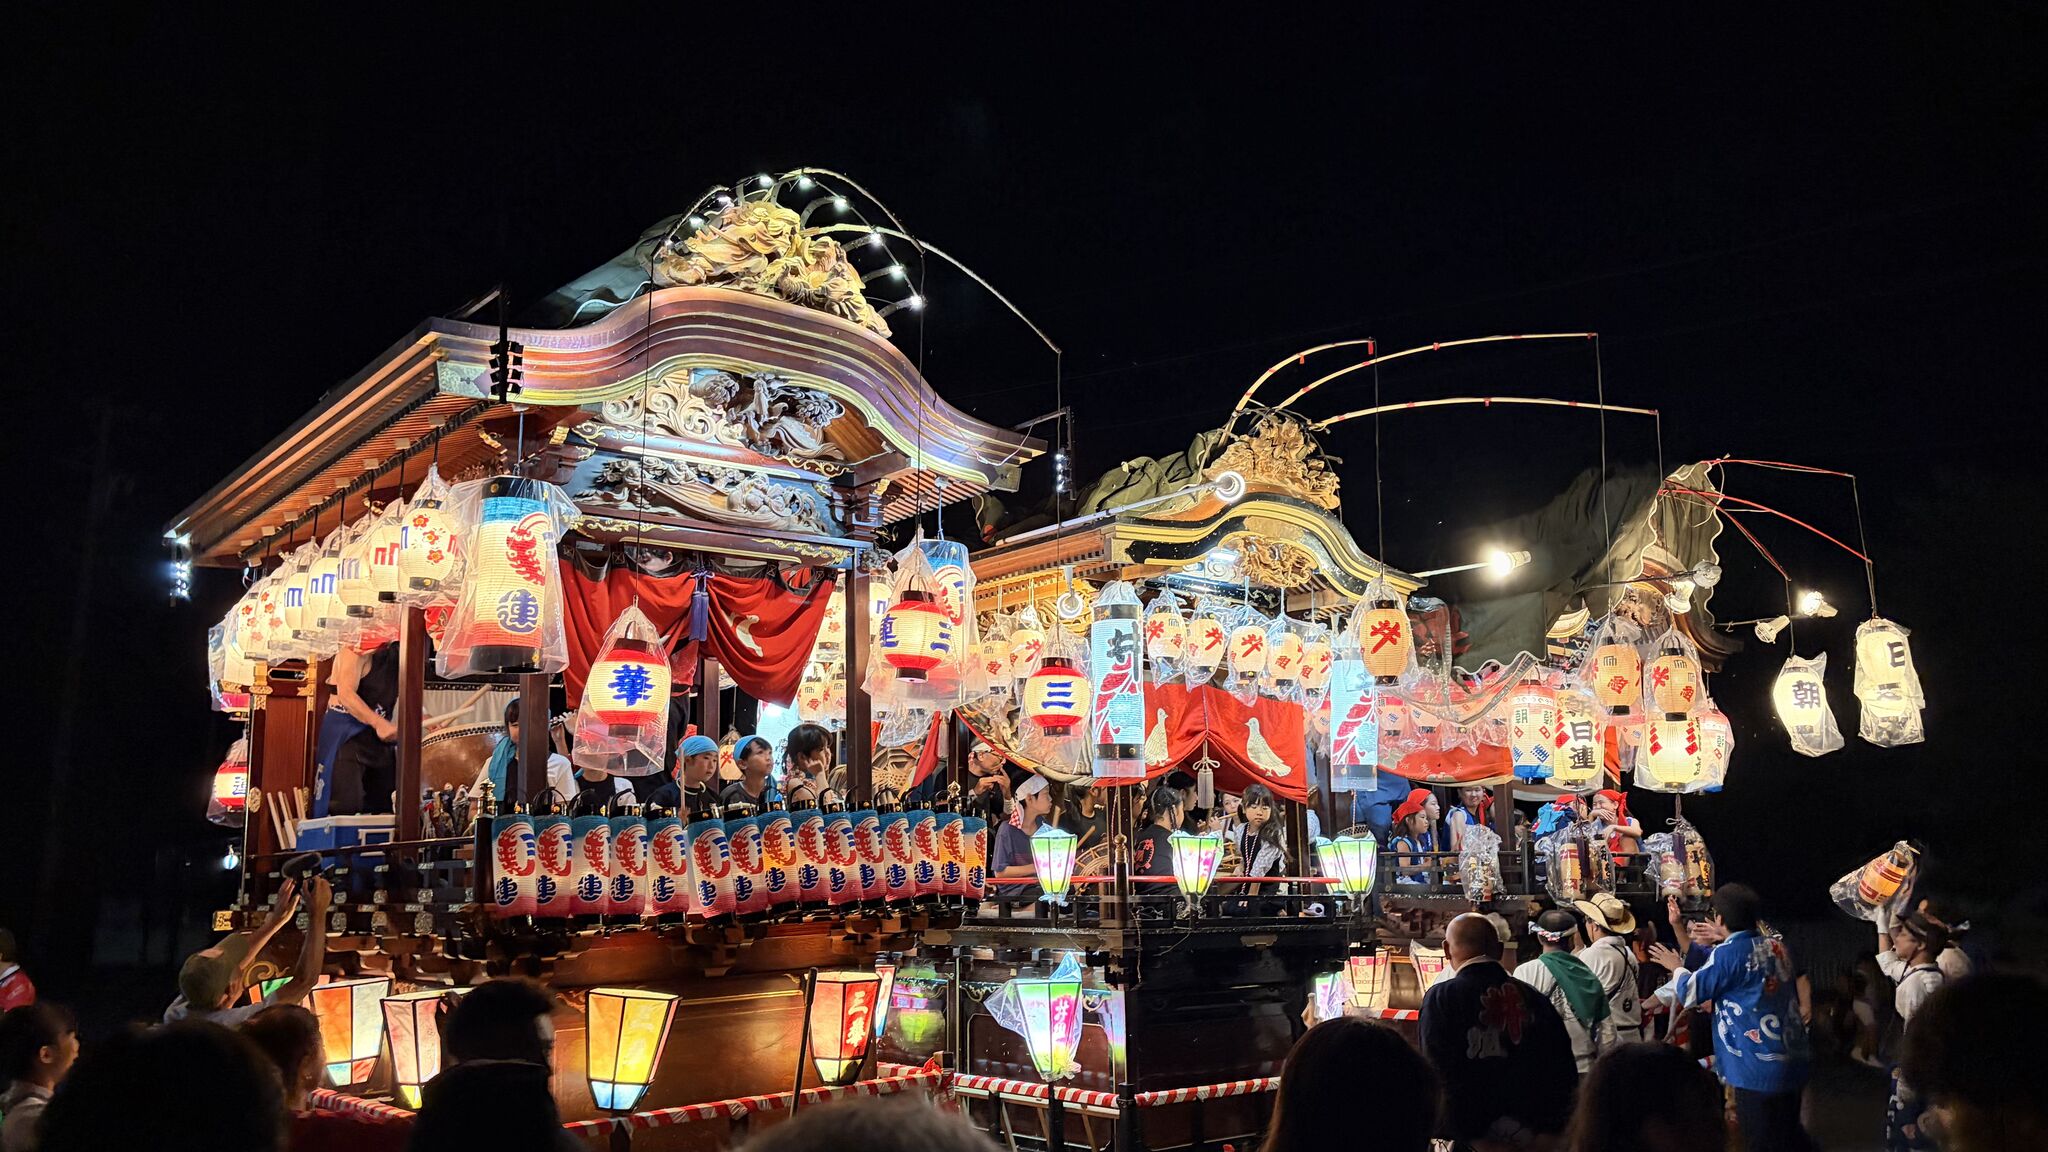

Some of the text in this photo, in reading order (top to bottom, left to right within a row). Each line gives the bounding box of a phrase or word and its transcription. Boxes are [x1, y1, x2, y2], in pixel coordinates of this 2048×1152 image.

[497, 588, 539, 633] 連
[1041, 681, 1077, 709] 三
[1792, 680, 1821, 709] 朝
